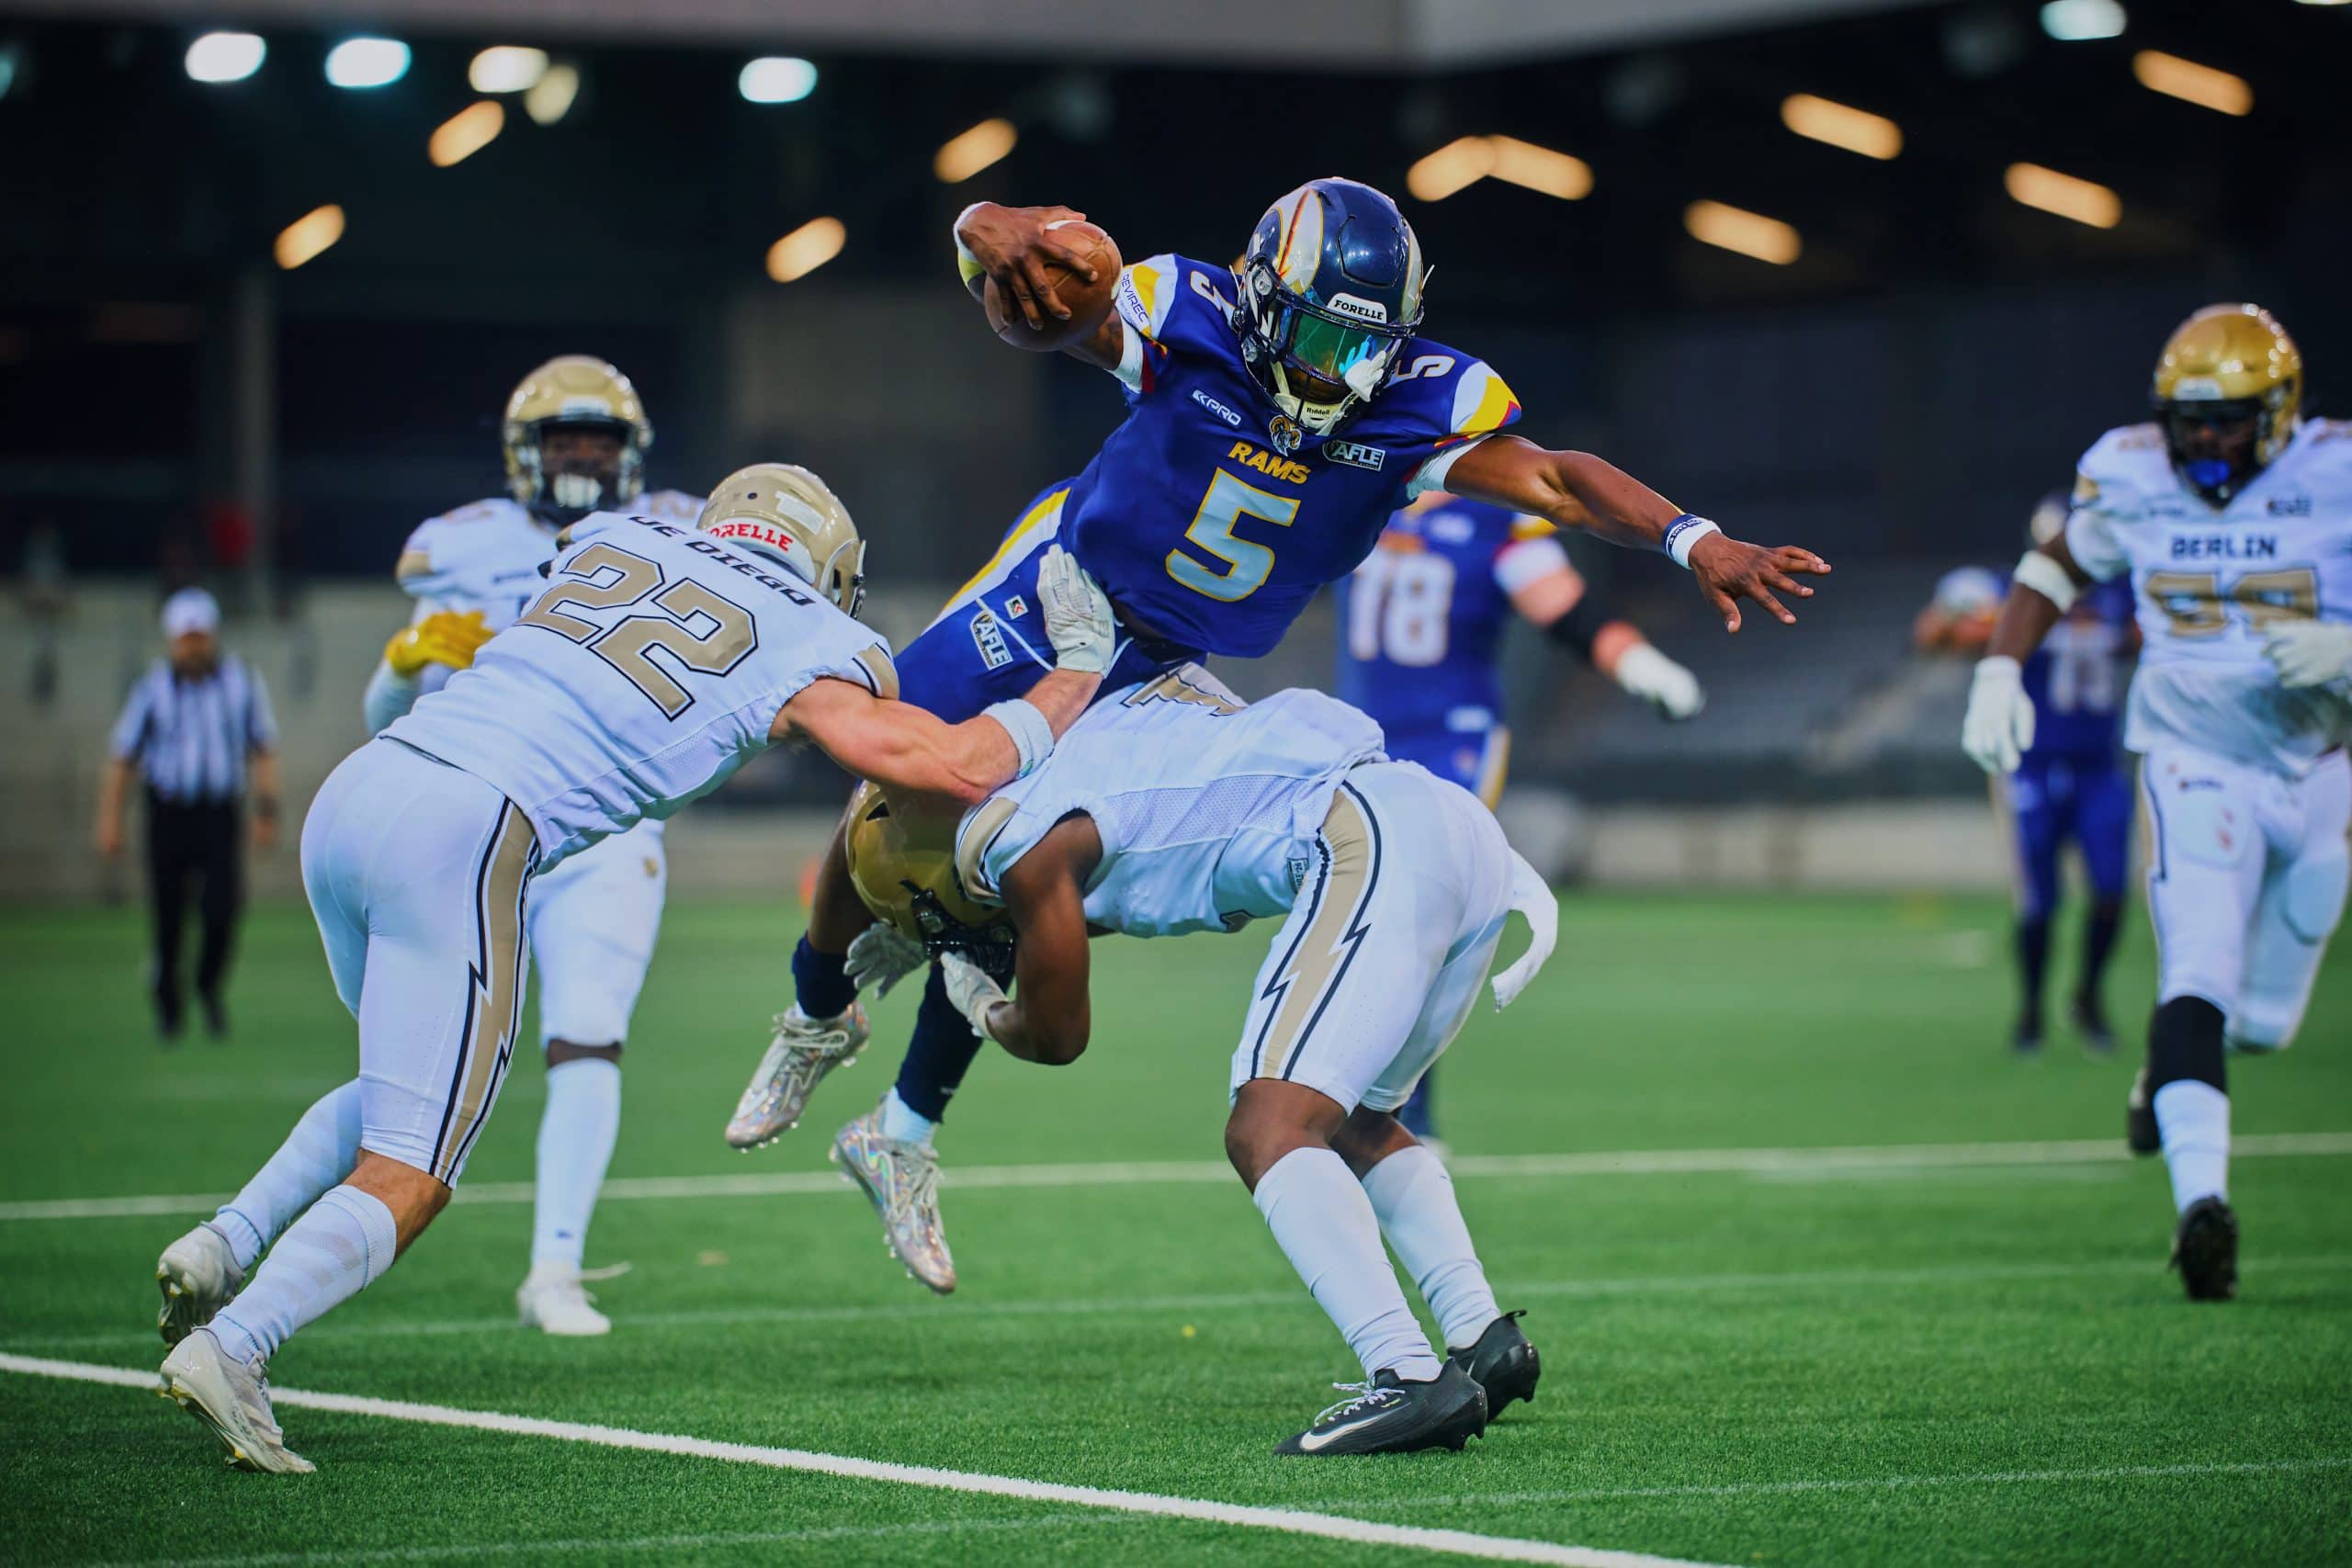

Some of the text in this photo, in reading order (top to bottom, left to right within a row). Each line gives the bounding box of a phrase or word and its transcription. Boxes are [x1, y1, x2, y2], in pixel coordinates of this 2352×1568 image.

[1334, 299, 1385, 321] FORELLE
[1306, 407, 1330, 415] Riddell
[1227, 441, 1311, 484] RAMS
[1331, 443, 1382, 466] AFLE
[708, 523, 794, 552] ORELLE
[1165, 466, 1301, 603] 5
[2170, 536, 2278, 559] BERLIN
[514, 542, 758, 722] 22
[975, 622, 1010, 666] AFLE
